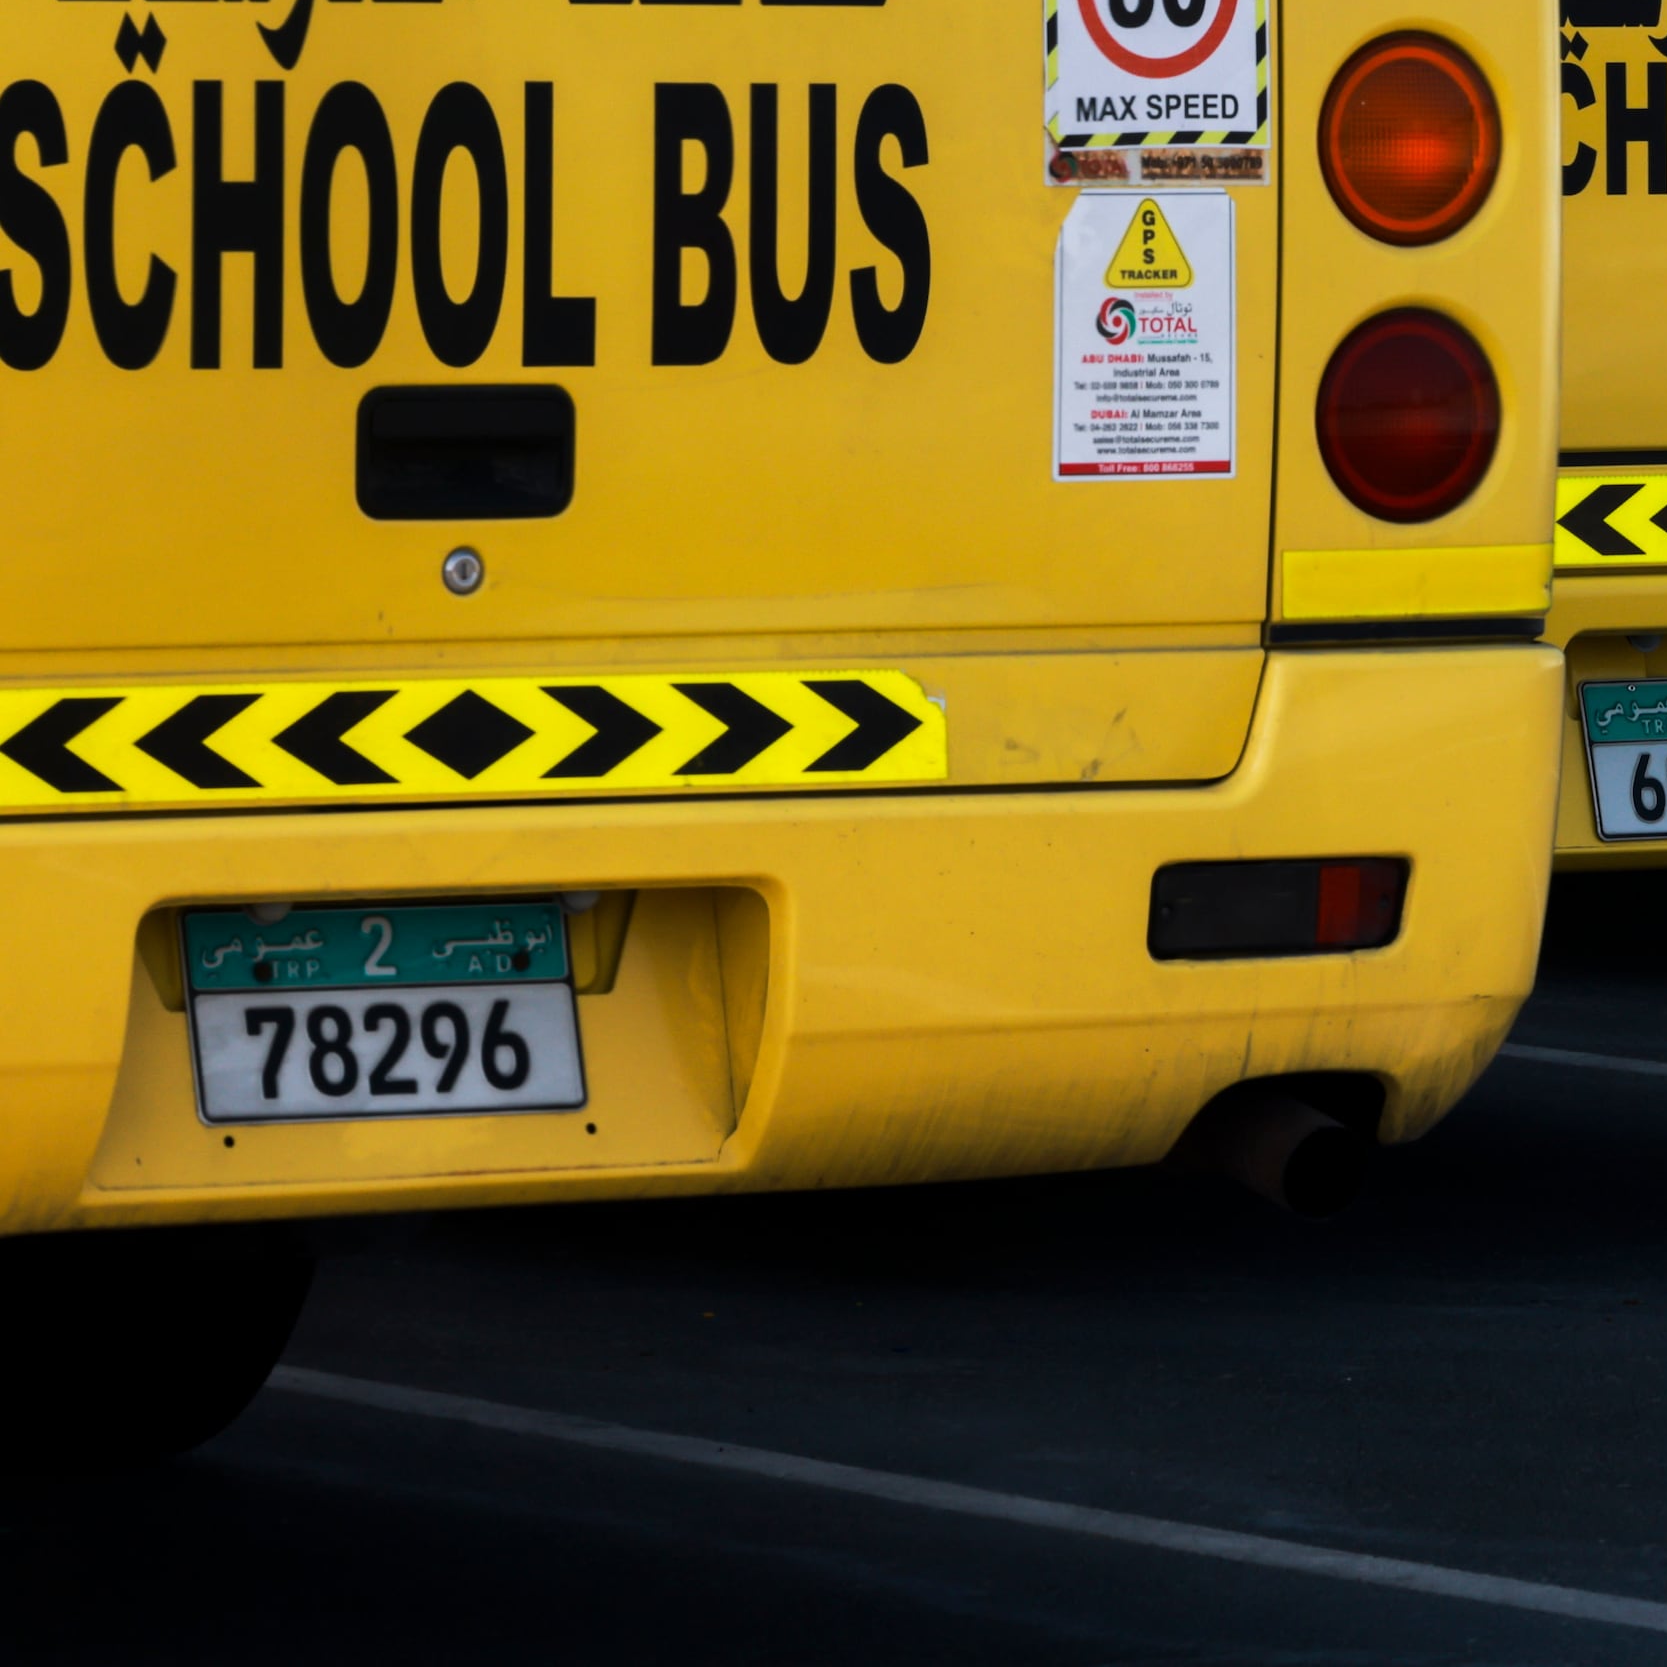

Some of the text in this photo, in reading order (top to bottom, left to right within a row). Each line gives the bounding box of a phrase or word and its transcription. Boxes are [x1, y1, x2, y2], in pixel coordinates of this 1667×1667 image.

[1076, 94, 1239, 121] MAX SPEED
[0, 79, 931, 371] SCHOOL BUS
[1120, 270, 1178, 280] TRACKER
[1139, 318, 1197, 332] TOTAL
[361, 916, 398, 976] 2
[245, 1000, 530, 1100] 78296
